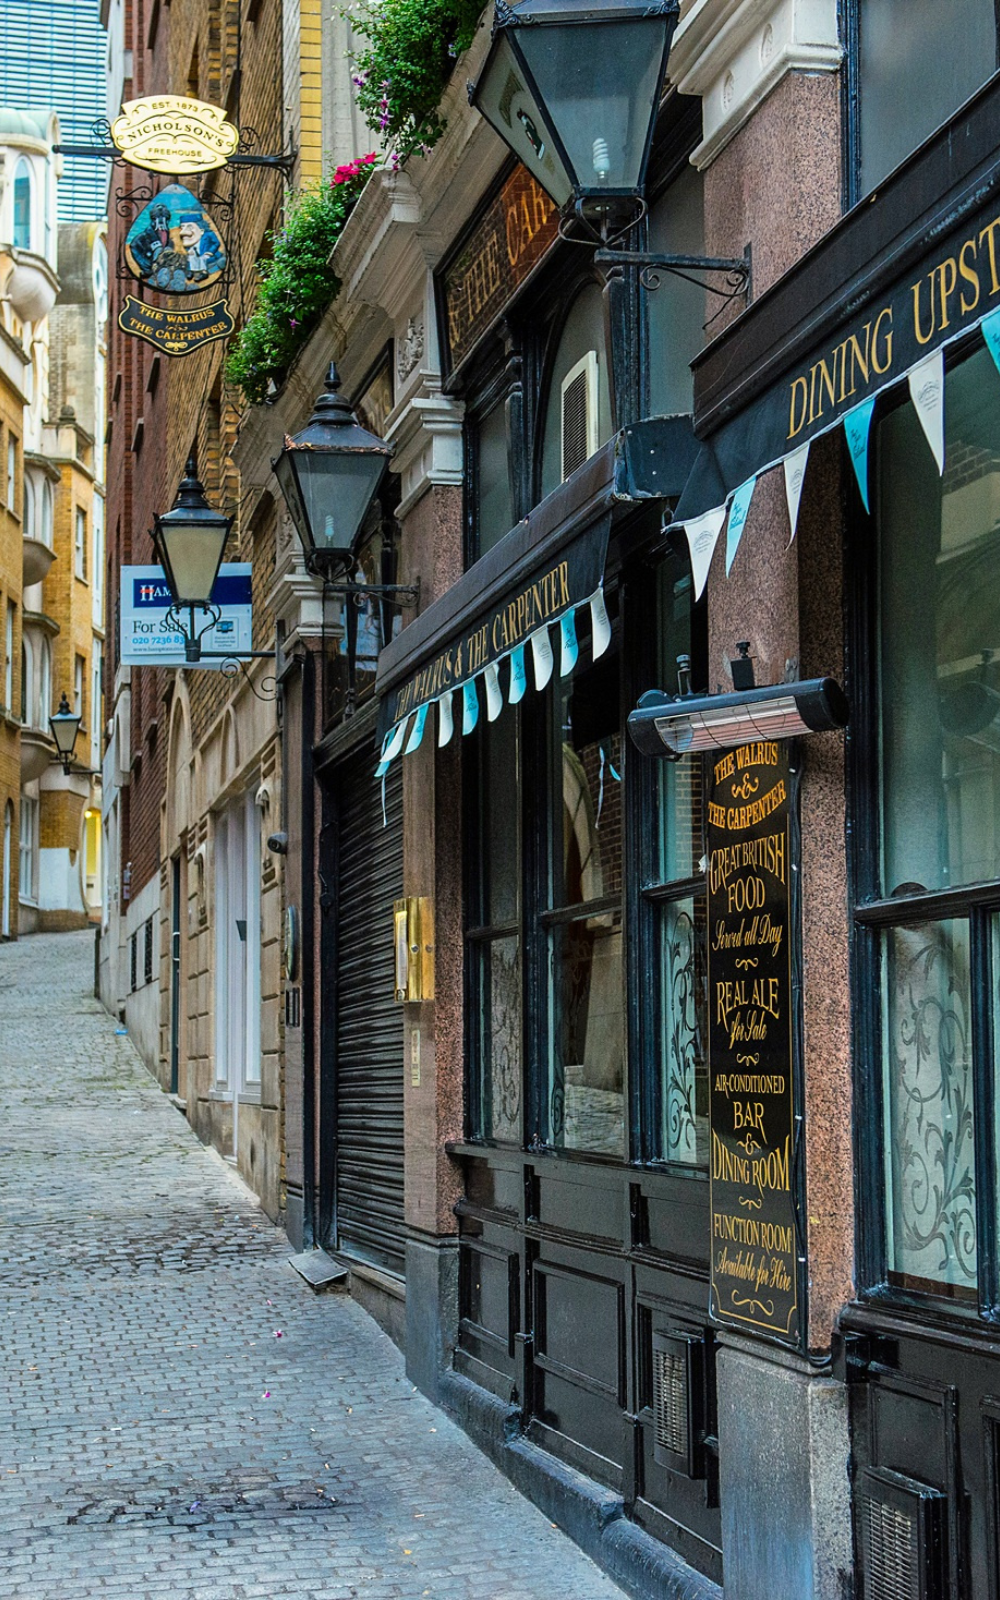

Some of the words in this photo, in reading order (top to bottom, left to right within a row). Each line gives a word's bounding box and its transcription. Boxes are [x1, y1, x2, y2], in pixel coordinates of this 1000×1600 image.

[151, 101, 172, 110] EST.
[176, 102, 198, 112] 1873
[127, 122, 224, 147] NICHOLSON'S
[148, 148, 202, 157] FREEHOUSE
[130, 317, 154, 335] THE
[155, 321, 228, 341] CARPENTER
[139, 305, 164, 321] THE
[166, 309, 215, 324] WALRUS
[786, 305, 893, 440] DINING
[140, 584, 172, 601] HAM
[132, 620, 156, 633] For
[159, 619, 188, 633] Sale
[132, 637, 150, 645] 020
[151, 635, 172, 645] 7236
[173, 635, 185, 645] 83
[413, 648, 453, 703] WALRUS
[454, 641, 462, 678] &
[467, 623, 489, 673] THE
[492, 560, 570, 652] CARPENTER
[714, 752, 735, 785] THE
[736, 742, 779, 770] WALRUS
[708, 801, 726, 829] THE
[727, 779, 787, 830] CARPENTER
[731, 772, 759, 799] &
[710, 844, 741, 895] GREAT
[742, 832, 785, 885] BRITISH
[728, 875, 765, 913] FOOD
[712, 918, 745, 951] Served
[744, 915, 759, 946] all
[758, 913, 783, 957] Day
[716, 980, 749, 1033] REAL
[751, 978, 779, 1019] ALE
[729, 1011, 745, 1050] for
[744, 1010, 767, 1042] Sale
[714, 1074, 785, 1099] AIR-CONDITIONED
[733, 1101, 768, 1144] BAR
[712, 1127, 750, 1184] DINING
[752, 1134, 790, 1199] ROOM
[736, 1132, 761, 1155] &
[713, 1213, 760, 1246] FUNCTION
[761, 1222, 791, 1256] ROOM
[714, 1246, 756, 1281] Available
[754, 1255, 769, 1292] for
[769, 1257, 791, 1291] Hire
